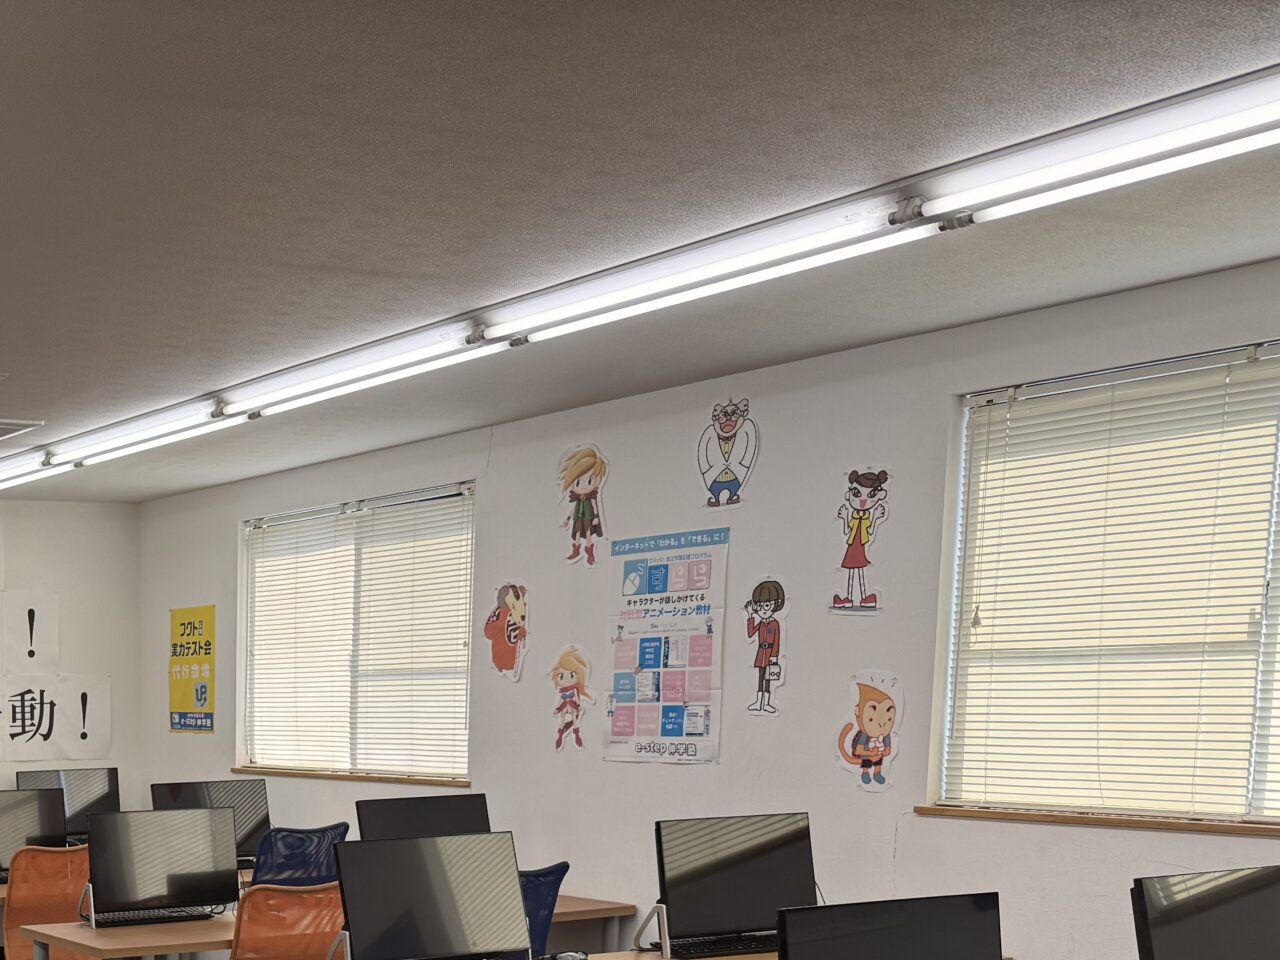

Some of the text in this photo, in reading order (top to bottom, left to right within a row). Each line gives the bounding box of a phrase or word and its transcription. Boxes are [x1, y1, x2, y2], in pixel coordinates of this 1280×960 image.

[171, 640, 212, 657] 実力テスト会
[635, 742, 666, 756] e-step
